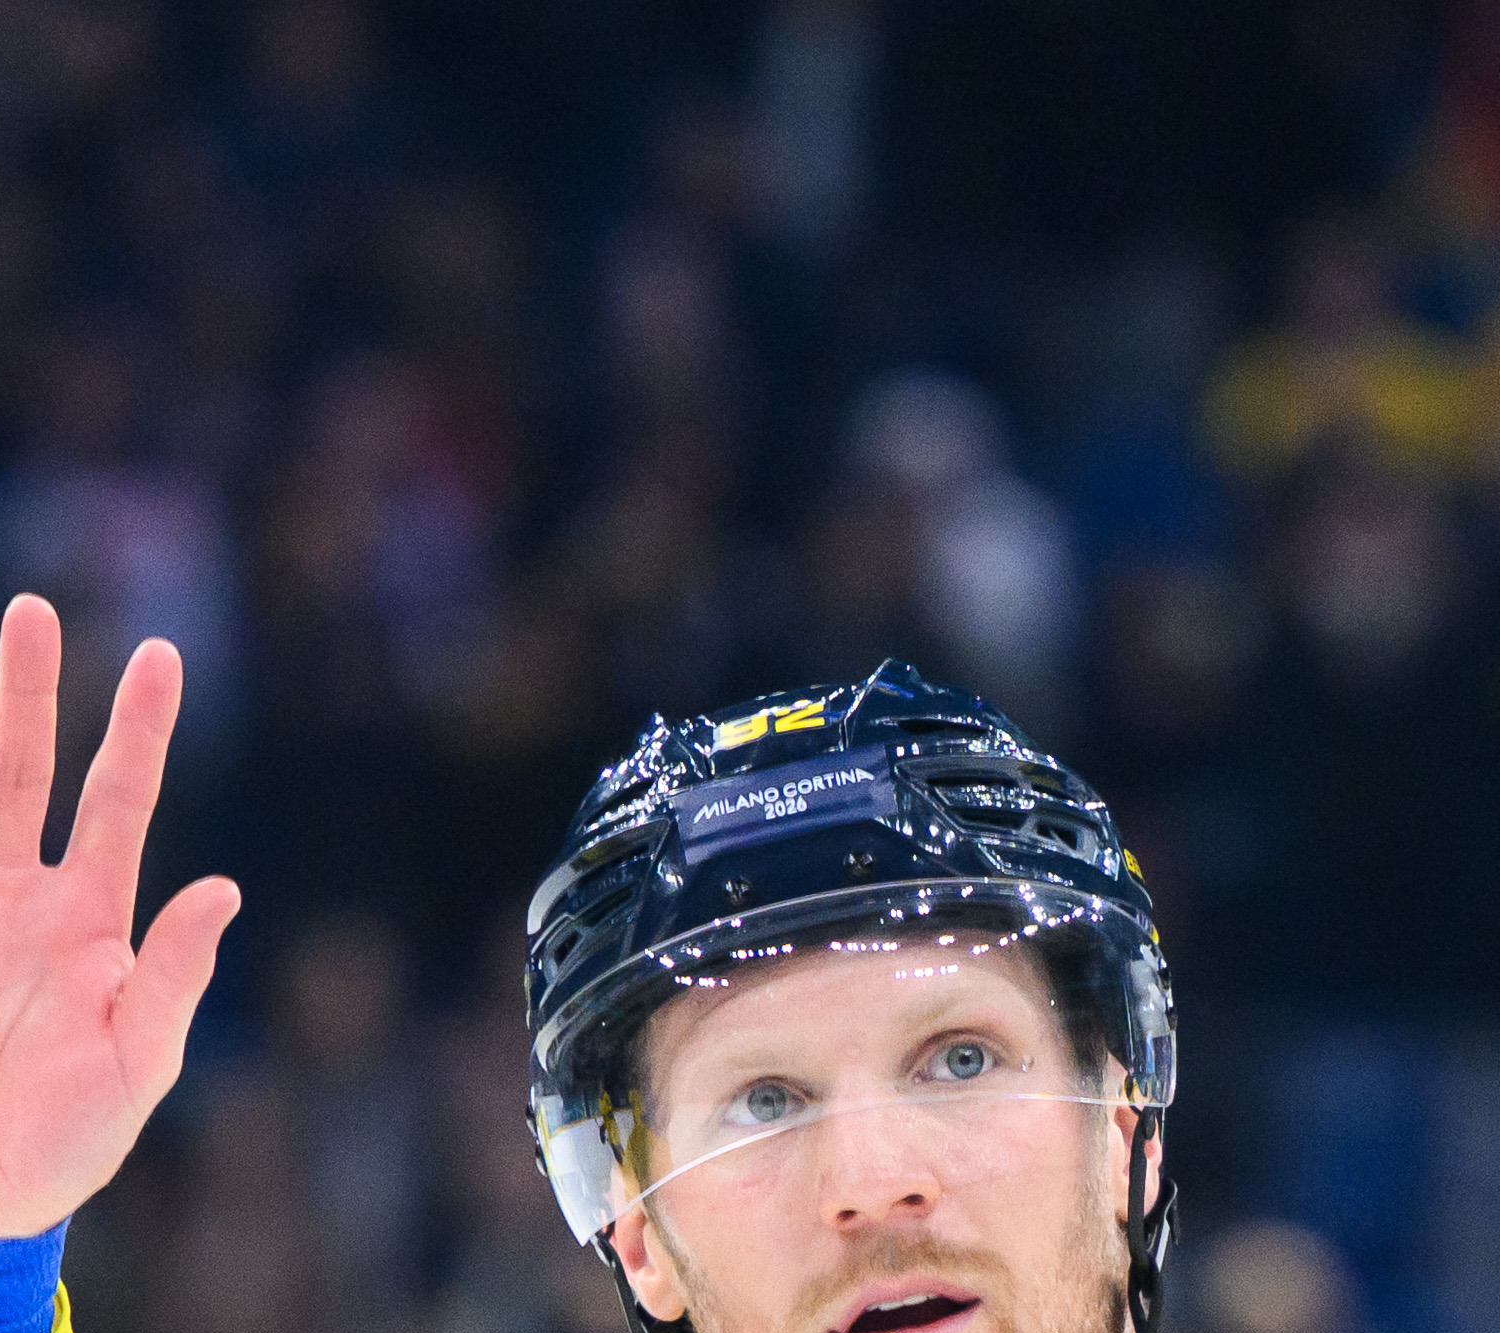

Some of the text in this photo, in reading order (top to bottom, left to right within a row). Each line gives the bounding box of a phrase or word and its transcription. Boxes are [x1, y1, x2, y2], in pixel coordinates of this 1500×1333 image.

[693, 768, 875, 824] MILANO CORTINA
[764, 796, 808, 820] 2026
